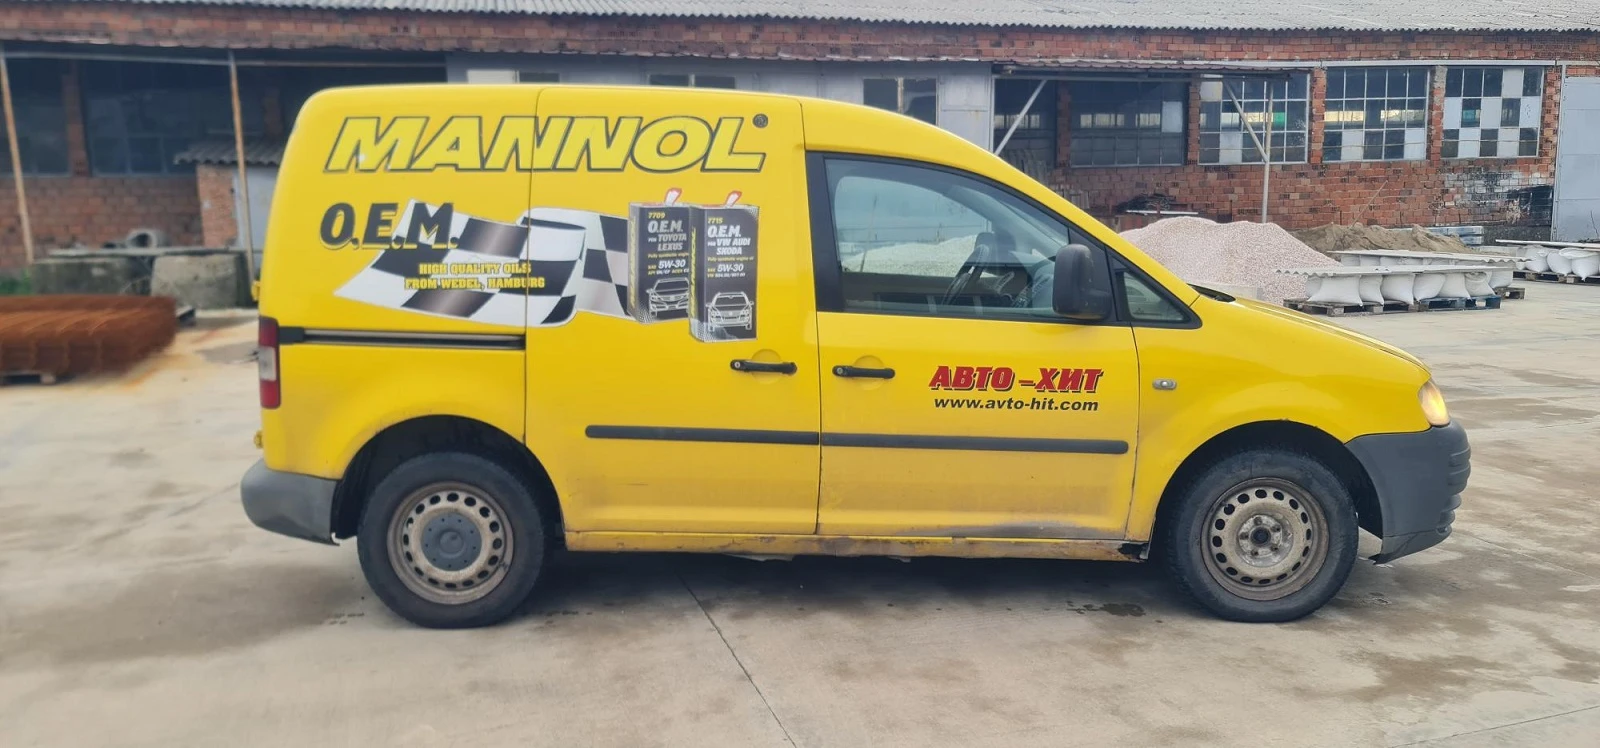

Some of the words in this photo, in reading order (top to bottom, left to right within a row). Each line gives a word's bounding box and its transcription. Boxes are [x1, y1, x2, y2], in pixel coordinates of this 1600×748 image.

[322, 115, 768, 173] MANNOL
[319, 202, 460, 250] O.E.M.
[647, 220, 683, 233] O.E.M.
[707, 225, 741, 238] O.E.M.
[658, 233, 687, 242] TOYOTA
[716, 238, 731, 247] VW
[732, 238, 751, 246] AUDI
[657, 242, 683, 251] LEXUS
[716, 247, 742, 255] SKODA
[419, 262, 447, 275] HIGH
[450, 262, 501, 275] QUALITY
[502, 262, 532, 274] OILS
[658, 259, 686, 269] 5W-30
[717, 263, 744, 272] 5W-30
[404, 278, 437, 290] FROM
[440, 278, 484, 291] WEDEL,
[488, 277, 545, 289] HAMBURG
[934, 397, 1099, 411] www.avto-hit.com
